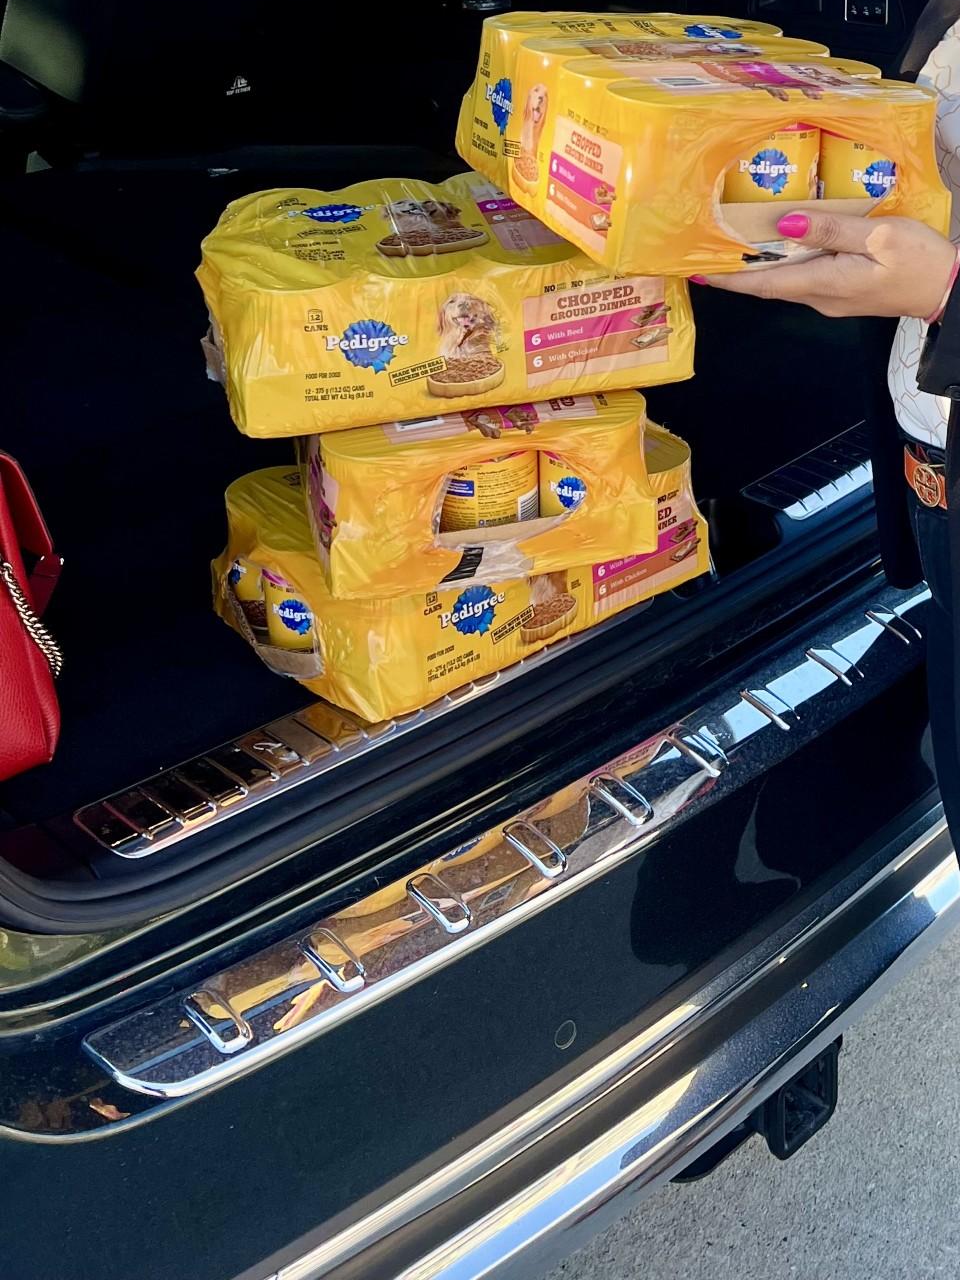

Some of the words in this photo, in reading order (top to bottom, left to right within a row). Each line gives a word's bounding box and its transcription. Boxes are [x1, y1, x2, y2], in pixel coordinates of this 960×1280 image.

[486, 83, 513, 114] Pedigr
[570, 130, 603, 159] CHOPPED
[854, 142, 865, 151] NO
[551, 159, 558, 173] 6
[739, 159, 799, 178] Pedigree
[852, 168, 897, 188] Pedigr
[549, 183, 556, 196] 6
[544, 284, 556, 294] NO
[570, 280, 584, 289] NO
[556, 284, 634, 310] CHOPPED
[310, 314, 321, 322] 12
[550, 305, 597, 322] GROUND
[598, 296, 642, 314] DINNER
[304, 324, 329, 333] CANS
[531, 333, 542, 346] 6
[547, 331, 566, 341] With
[566, 327, 584, 337] Beef
[326, 334, 409, 352] Pedigree
[532, 355, 544, 368] 6
[548, 352, 567, 363] With
[568, 345, 599, 360] Chicken
[391, 369, 410, 379] MADE
[410, 363, 427, 373] WITH
[550, 481, 586, 500] Pedigr
[597, 565, 606, 577] 6
[598, 584, 607, 596] 6
[272, 603, 314, 622] Pedigre
[423, 603, 443, 616] CANS
[440, 591, 506, 629] Pedigree
